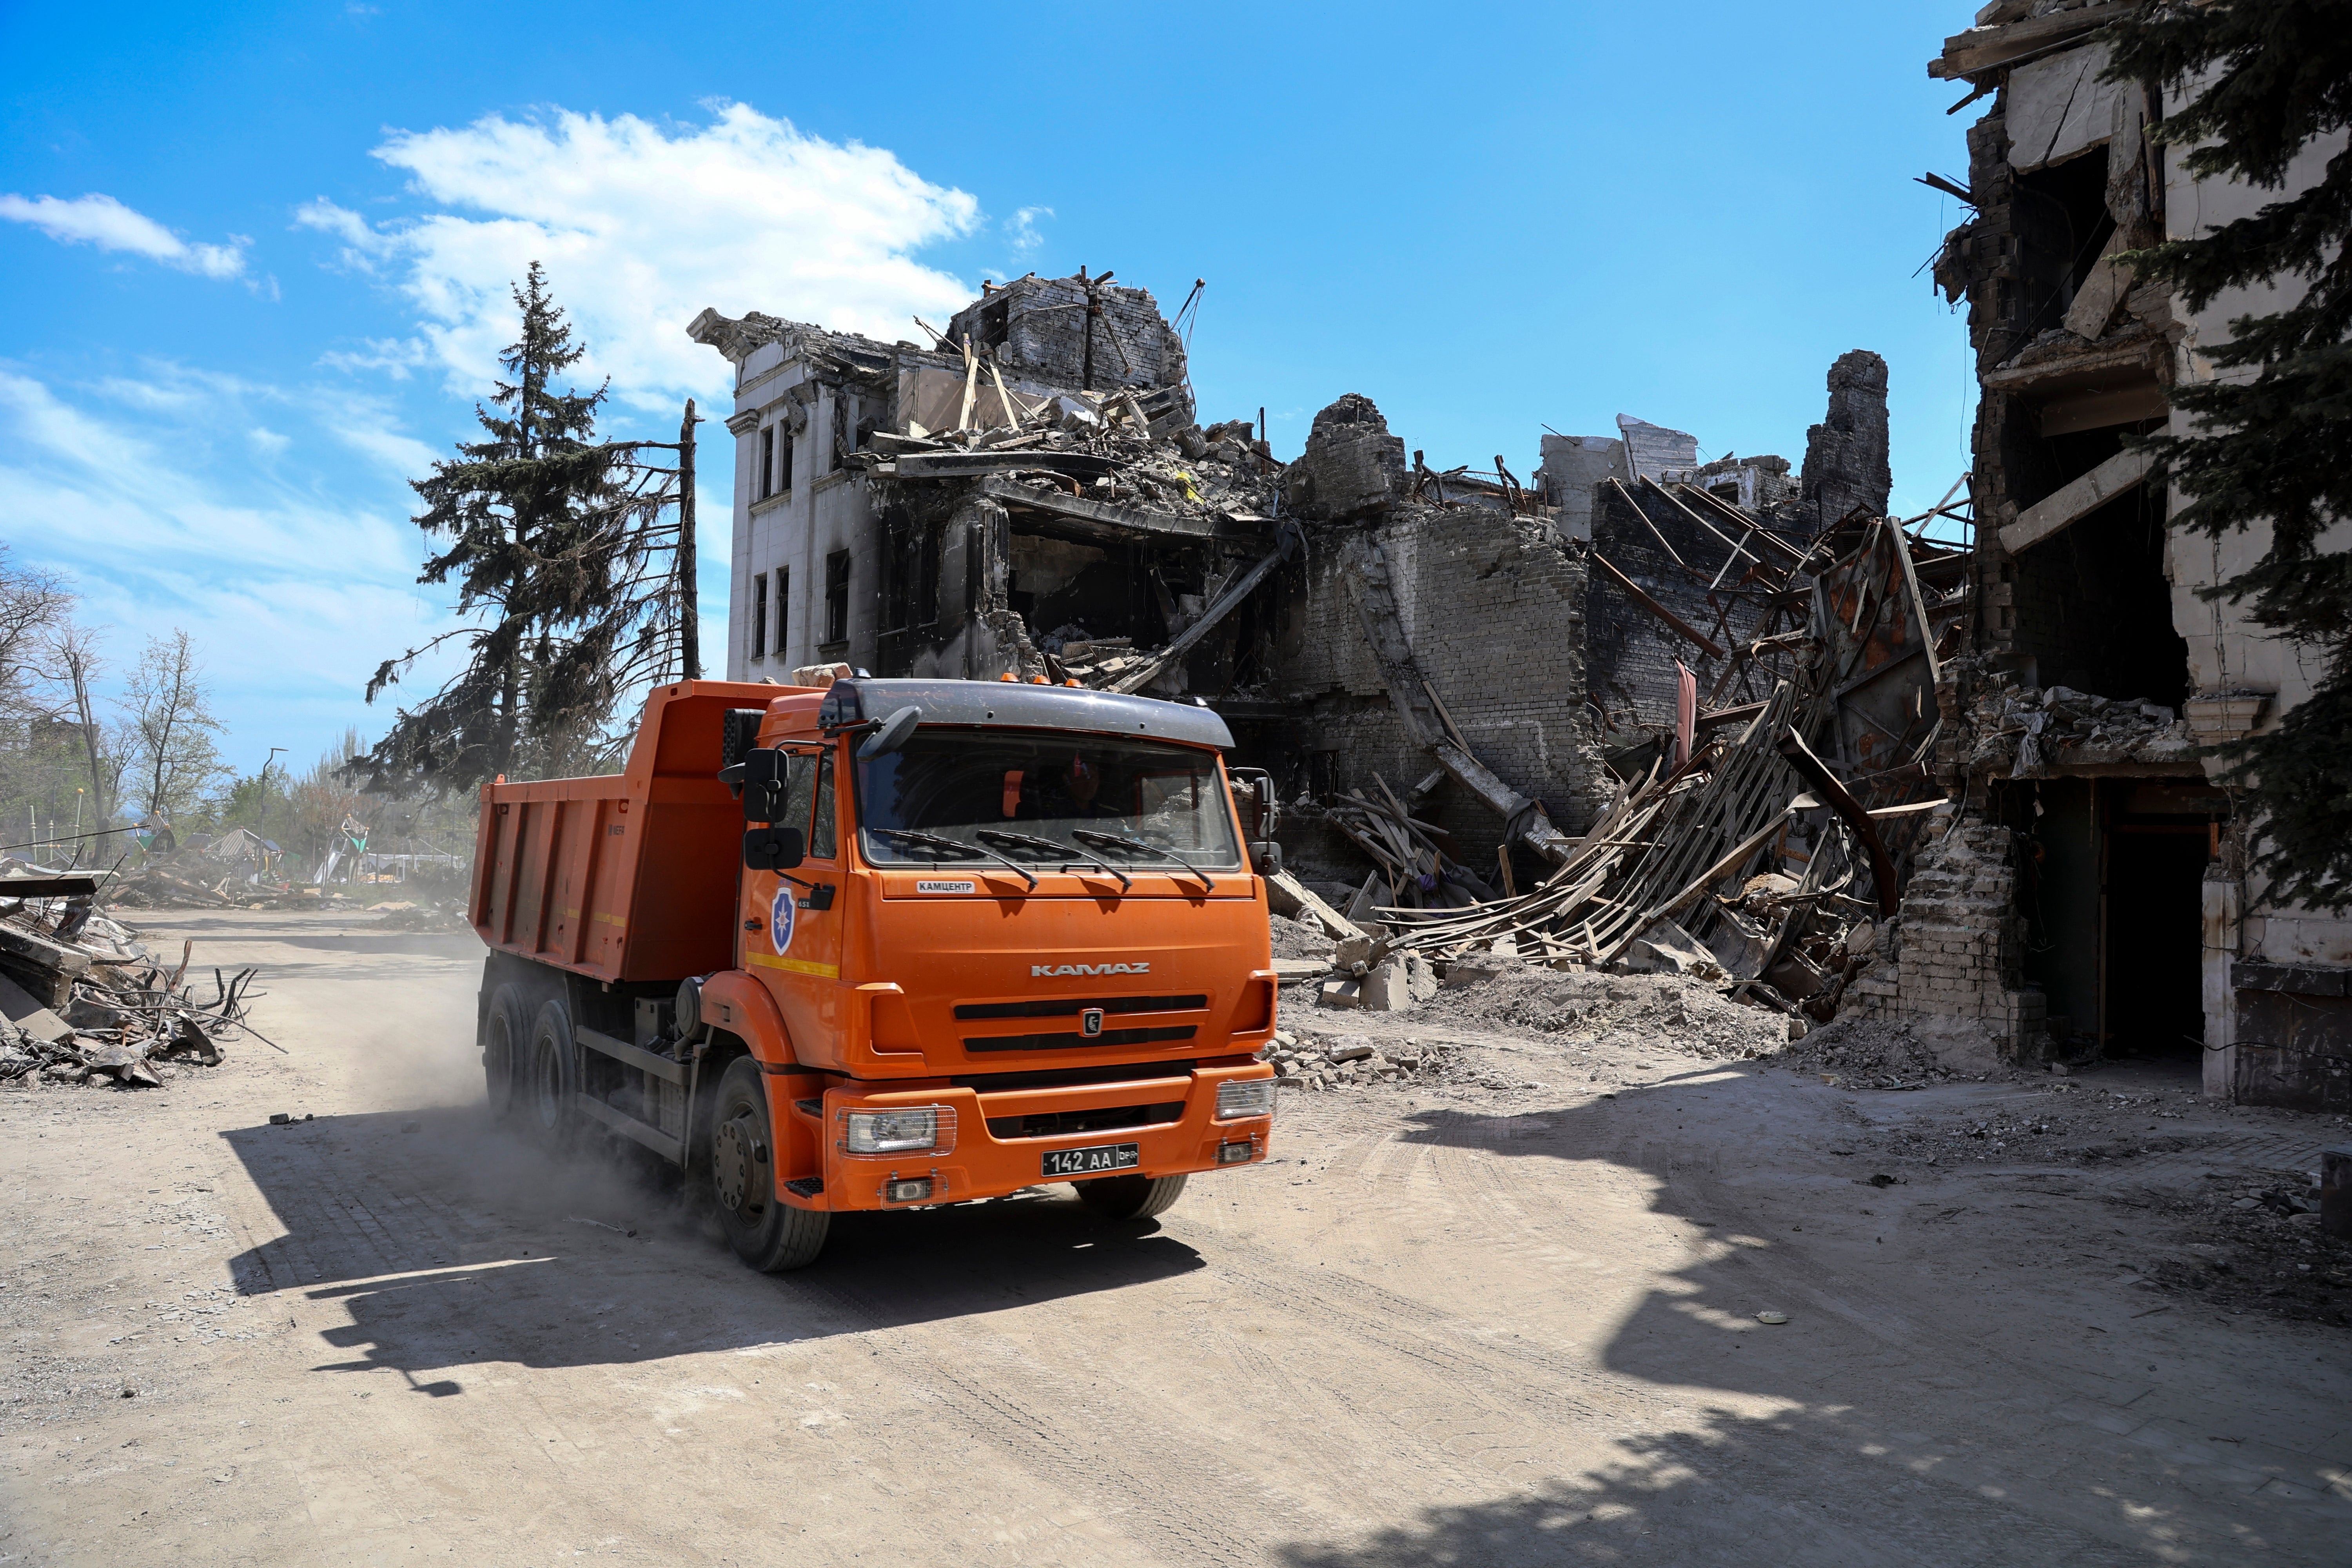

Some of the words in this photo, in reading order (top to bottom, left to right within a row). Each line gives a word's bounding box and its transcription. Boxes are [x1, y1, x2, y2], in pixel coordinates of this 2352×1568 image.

[613, 825, 625, 835] NEFA
[919, 882, 972, 891] КАМЦЕНТР
[1031, 962, 1150, 977] KAMAZ
[1051, 1152, 1083, 1172] 142
